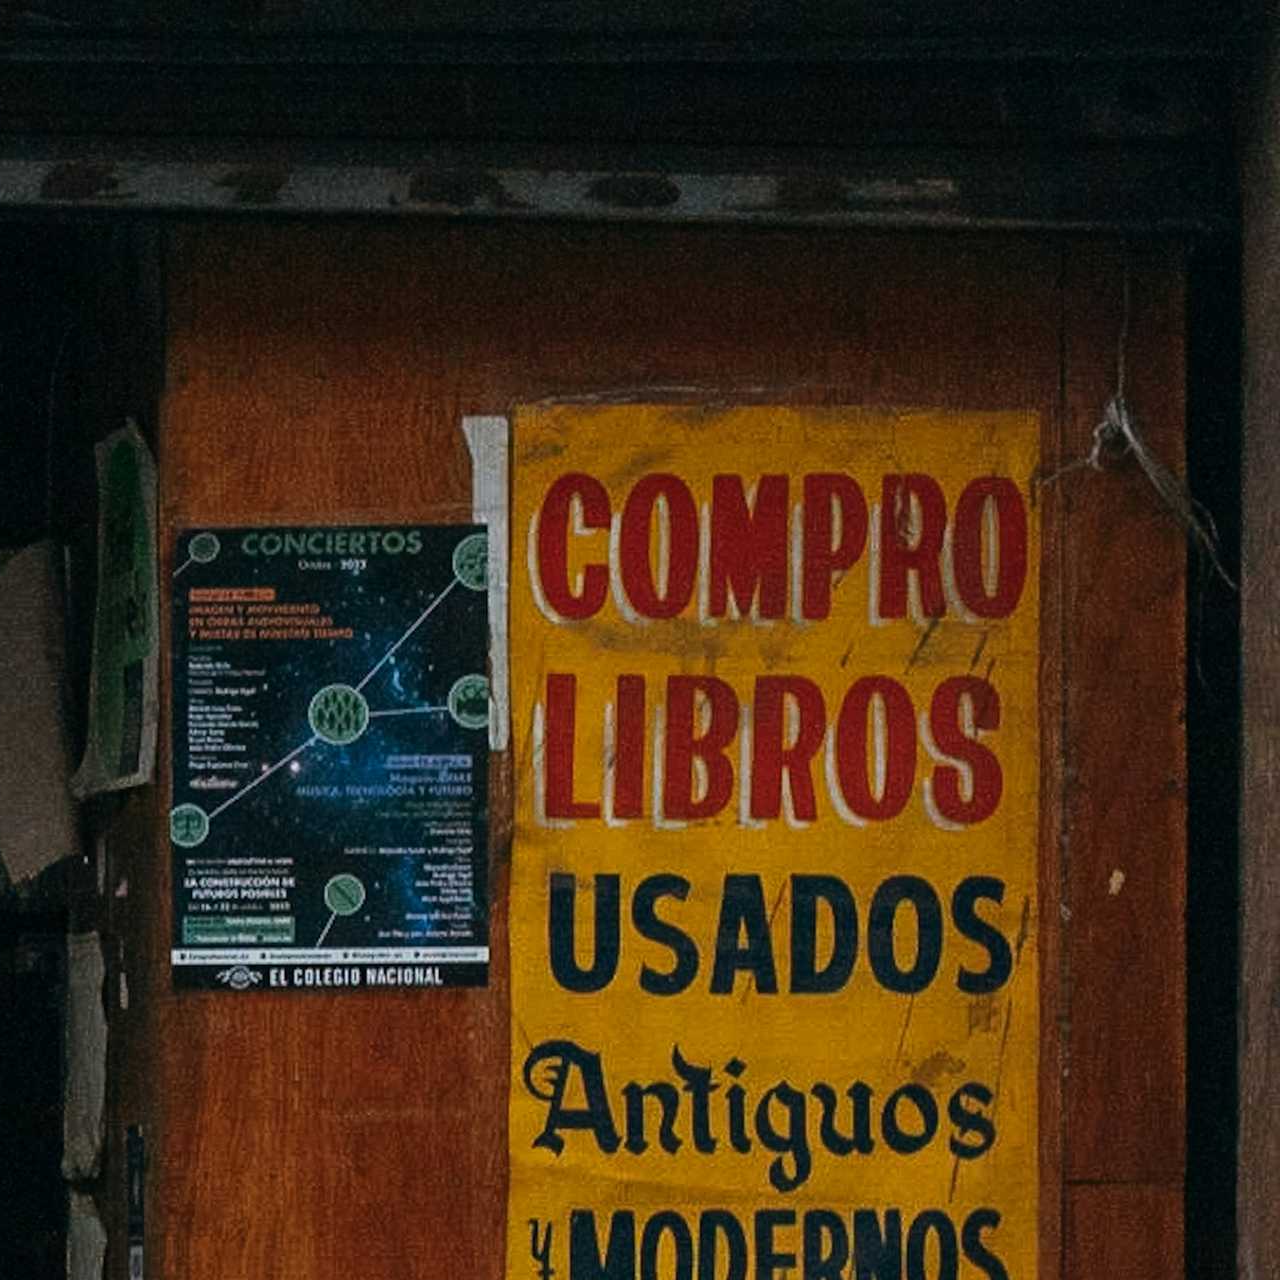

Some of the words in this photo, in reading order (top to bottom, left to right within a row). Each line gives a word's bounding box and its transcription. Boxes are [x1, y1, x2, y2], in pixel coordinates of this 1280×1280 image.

[241, 530, 424, 557] CONCIERTOS
[528, 471, 1028, 626] COMPRO
[533, 673, 1004, 830] LIBROS
[269, 968, 288, 987] EL
[292, 967, 361, 987] COLEGIO
[365, 966, 444, 986] NACIONAL
[548, 873, 1014, 996] USADOS
[523, 1038, 997, 1192] Antiguos
